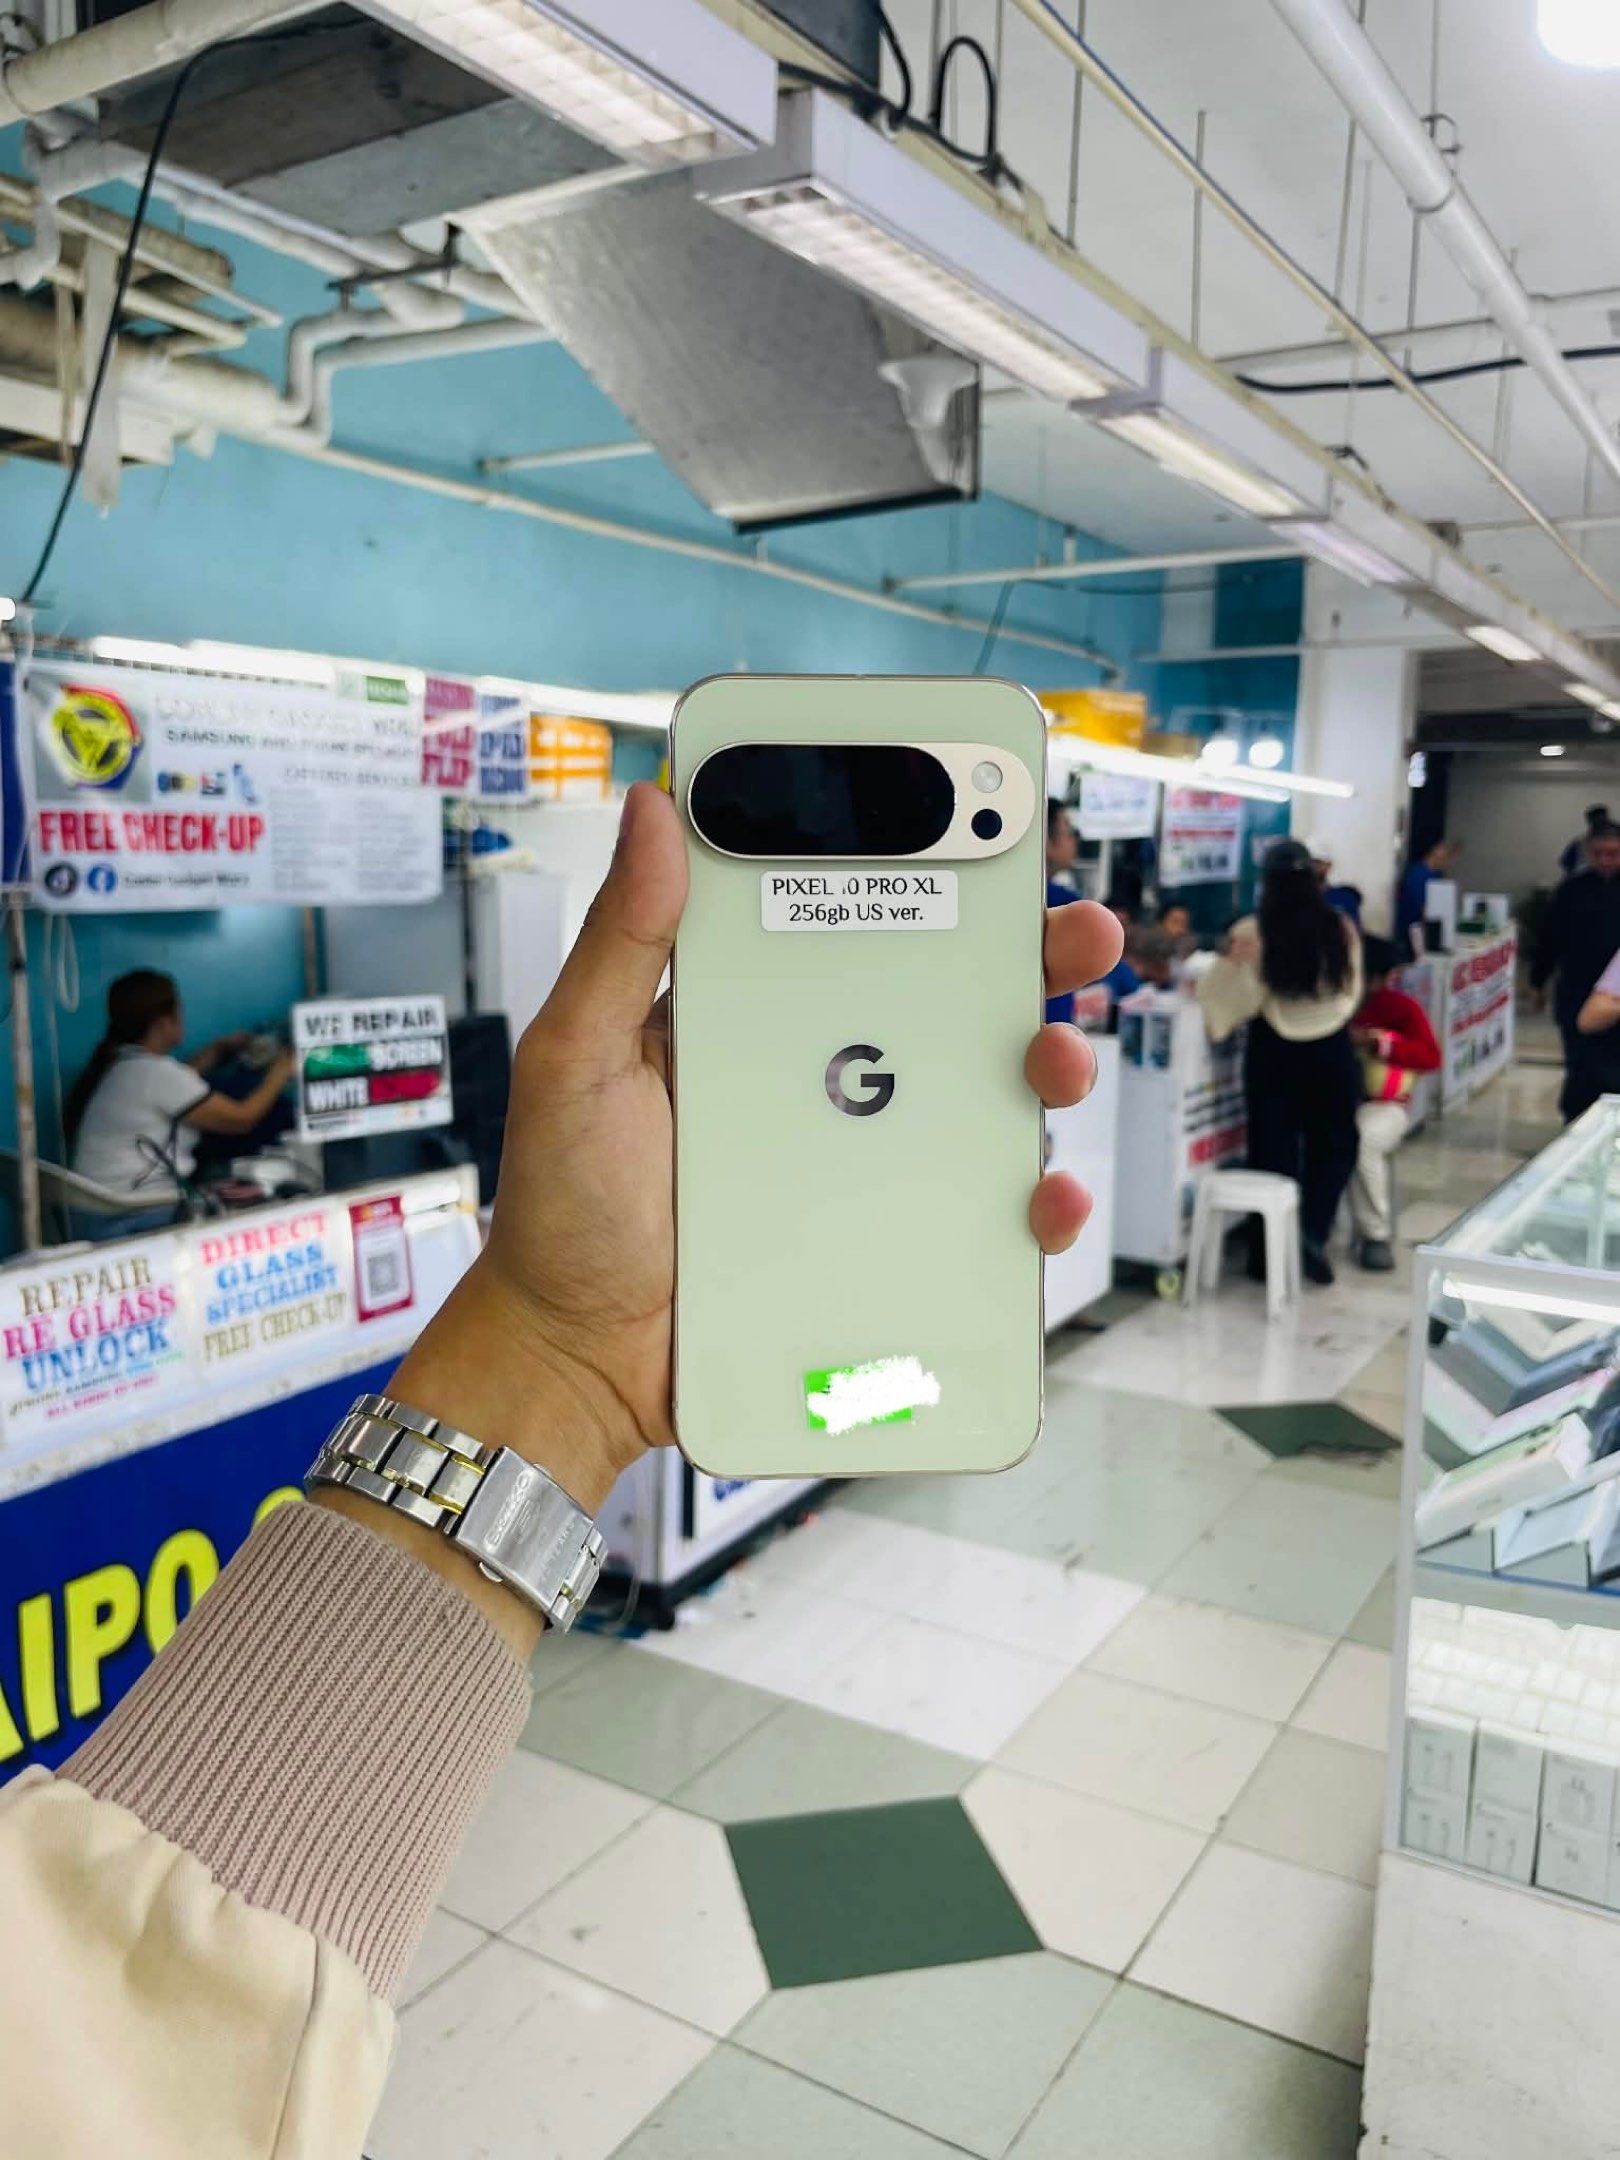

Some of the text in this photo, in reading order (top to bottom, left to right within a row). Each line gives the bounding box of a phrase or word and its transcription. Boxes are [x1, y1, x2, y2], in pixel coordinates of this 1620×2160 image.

[122, 811, 265, 853] CHECK-UP
[772, 877, 834, 896] PIXEL
[865, 877, 908, 896] PRO
[913, 877, 943, 896] XL
[789, 902, 924, 925] 256gb US ver.
[353, 1008, 436, 1031] REPAIR
[371, 1038, 443, 1071] SCREEN
[825, 1044, 894, 1116] G
[308, 1076, 369, 1114] WHITE
[201, 1211, 326, 1266] DIRECT
[19, 1257, 152, 1317] REPAIR
[216, 1242, 323, 1290] GLASS
[2, 1282, 176, 1359] RE GLASS
[206, 1265, 338, 1325] SPECIALIST
[204, 1293, 346, 1361] FREE CHECK-UP
[21, 1317, 170, 1392] UNLOCK
